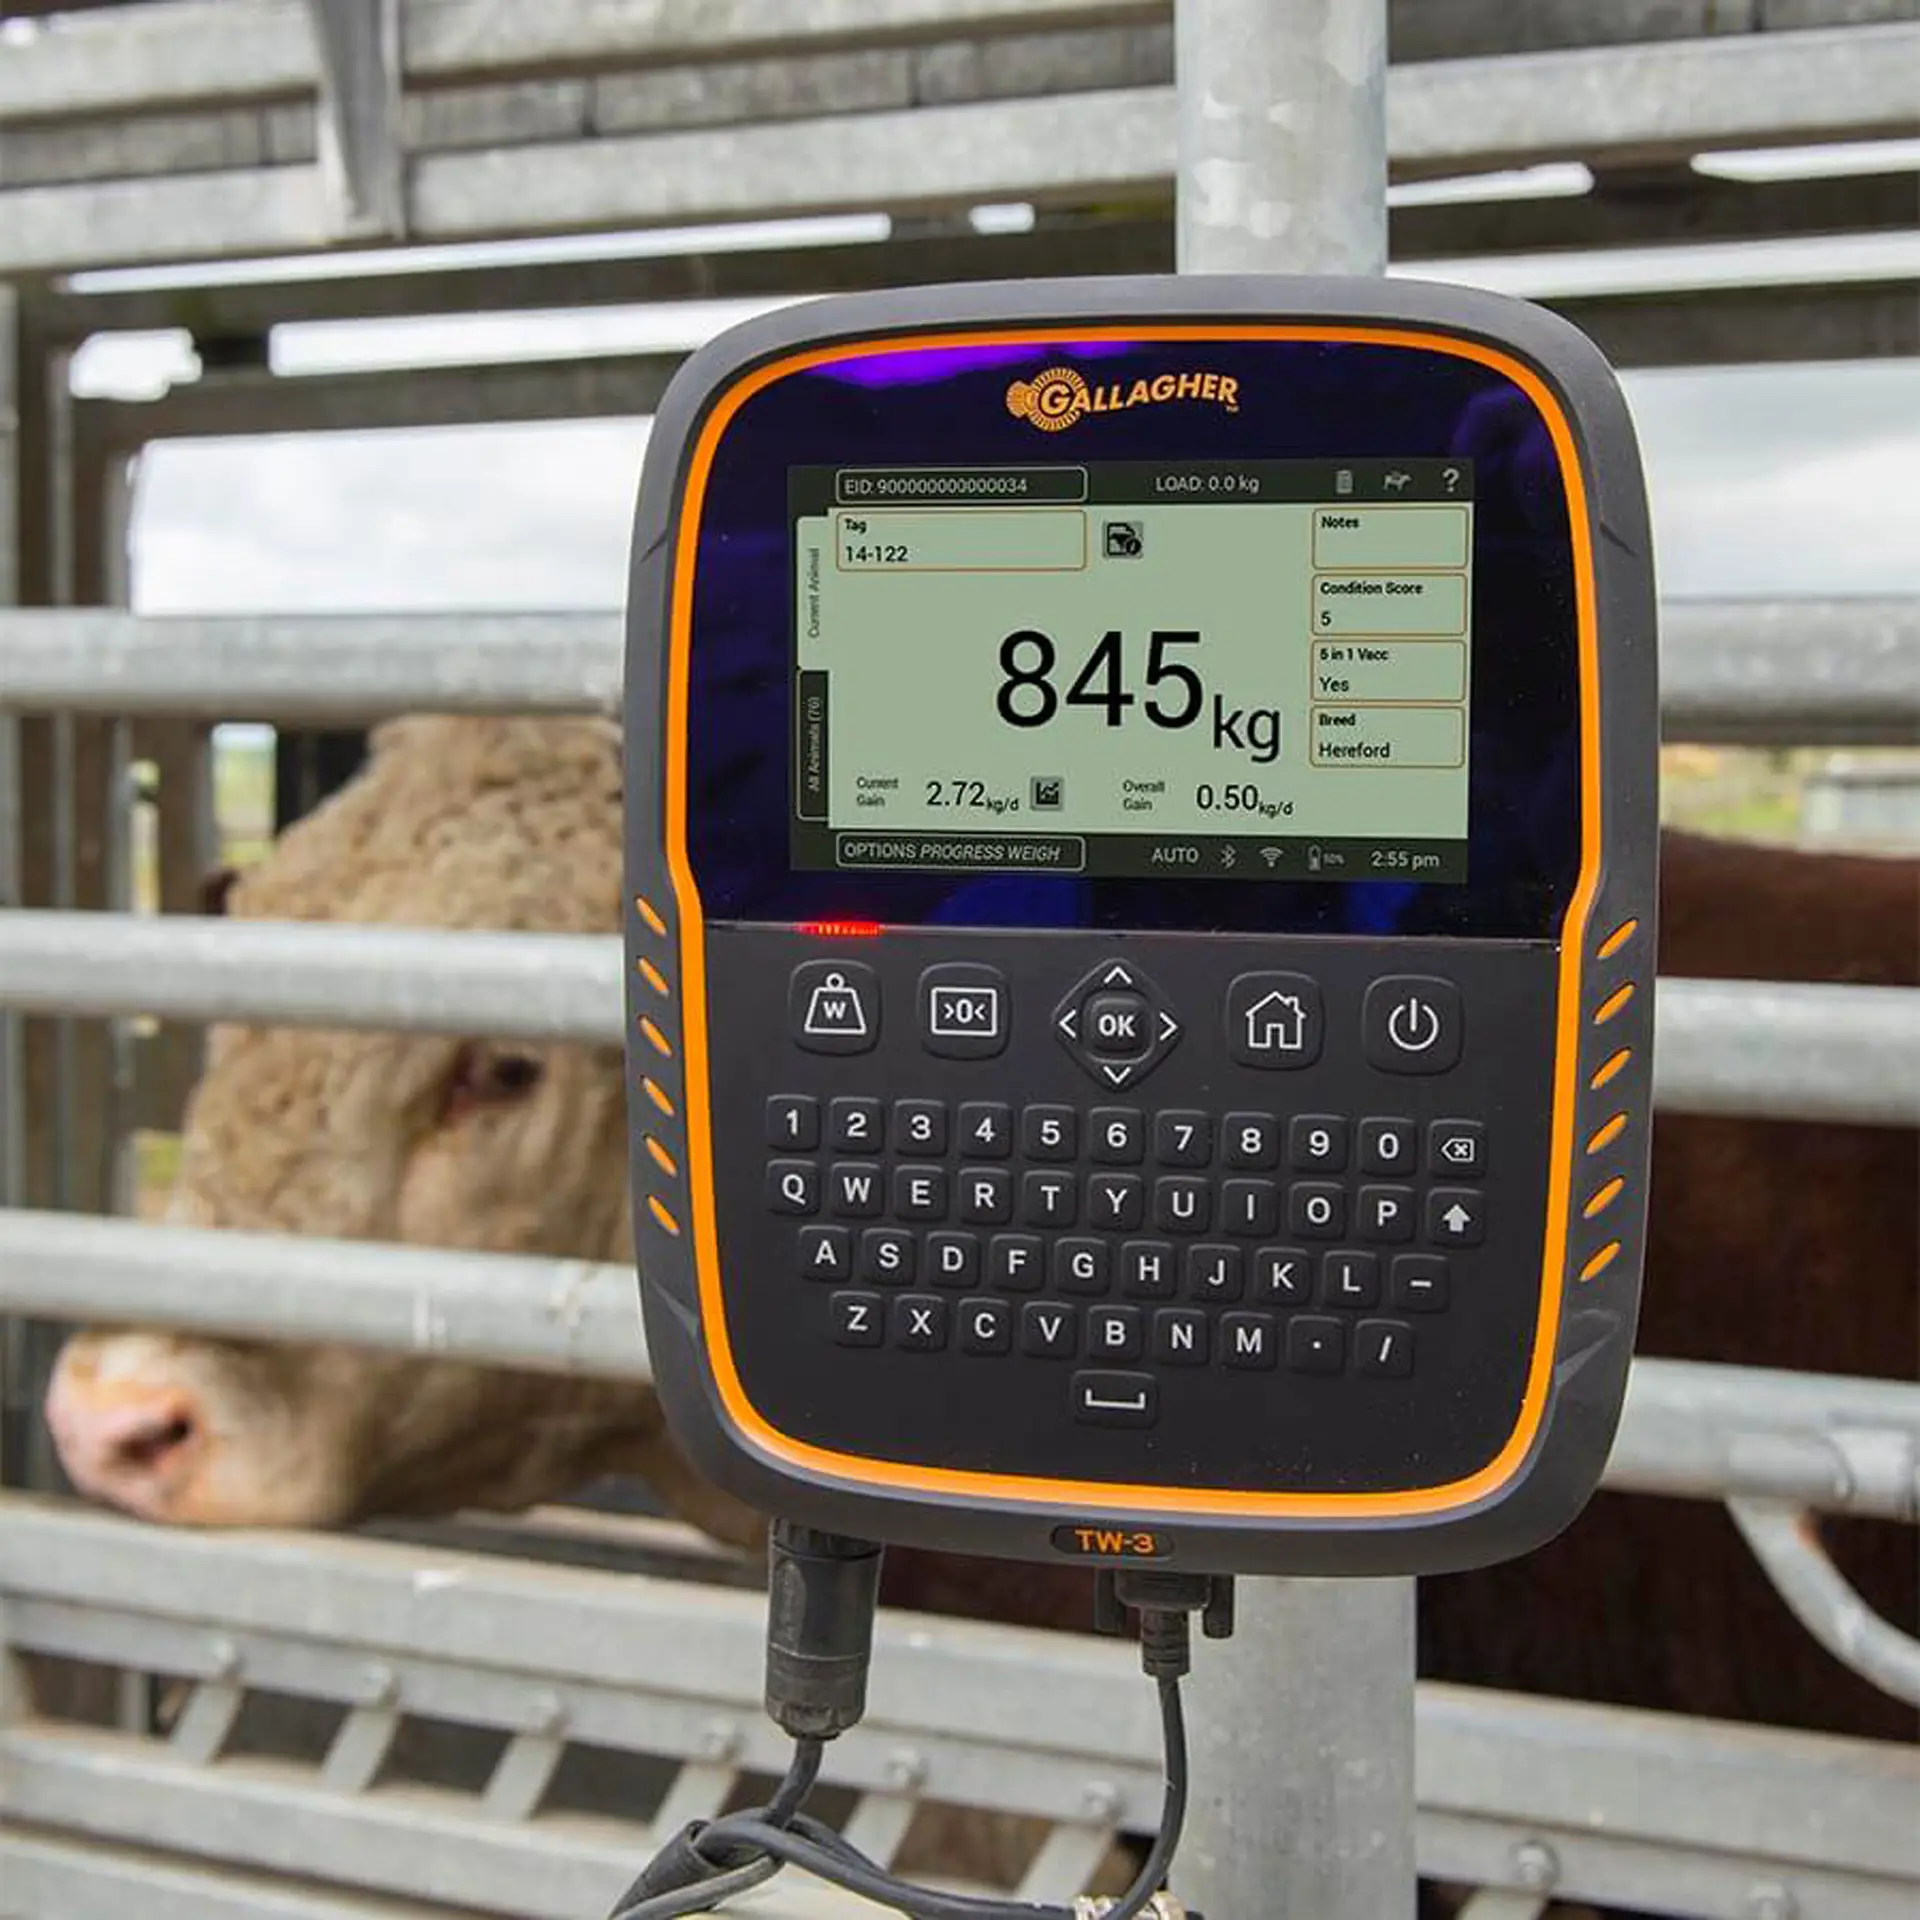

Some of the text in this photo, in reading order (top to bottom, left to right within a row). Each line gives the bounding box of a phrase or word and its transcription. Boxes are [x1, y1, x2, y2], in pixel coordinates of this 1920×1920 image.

[1040, 373, 1239, 416] GALLAGHER
[845, 478, 1027, 494] EID: 900000000000034
[1156, 475, 1260, 493] LOAD: 0.0 kg
[1442, 468, 1460, 492] ?
[844, 518, 867, 534] Tag
[1321, 515, 1360, 529] Notes
[846, 545, 908, 562] 14-122
[808, 548, 820, 638] Current Animal
[1320, 581, 1423, 596] Condition Score
[1321, 611, 1332, 627] 5
[1331, 648, 1344, 660] in
[1347, 648, 1354, 660] 1
[1357, 648, 1389, 660] Vacc
[1319, 676, 1350, 692] Yes
[996, 630, 1281, 764] 845 kg
[1319, 713, 1356, 727] Breed
[1318, 741, 1391, 759] Hereford
[856, 777, 899, 790] Current
[1122, 779, 1166, 794] Overall
[856, 794, 886, 807] Gain
[1122, 796, 1153, 811] Gain
[844, 843, 1061, 862] OPTIONS PROGRESS WEIGH
[1151, 847, 1200, 864] AUTO
[1371, 851, 1441, 871] 2:55 pm
[824, 1002, 845, 1018] W
[1099, 1015, 1134, 1036] OK
[787, 1110, 1398, 1158] 1 2 3 4 5 6 7 8 9 0
[783, 1174, 1397, 1225] Q W E R T Y U I O P
[816, 1240, 836, 1264] A
[880, 1243, 898, 1268] S
[944, 1246, 962, 1270] D
[1009, 1250, 1026, 1273] F
[1073, 1253, 1093, 1277] G
[1140, 1256, 1159, 1280] H
[1209, 1260, 1224, 1285] J
[1273, 1263, 1293, 1288] K
[1344, 1266, 1360, 1291] L
[848, 1306, 867, 1330] Z
[912, 1310, 931, 1334] X
[975, 1313, 994, 1337] C
[1040, 1317, 1060, 1341] V
[1107, 1321, 1124, 1344] B
[1173, 1324, 1192, 1348] N
[1238, 1328, 1261, 1352] M
[1075, 1529, 1154, 1554] TW-3
